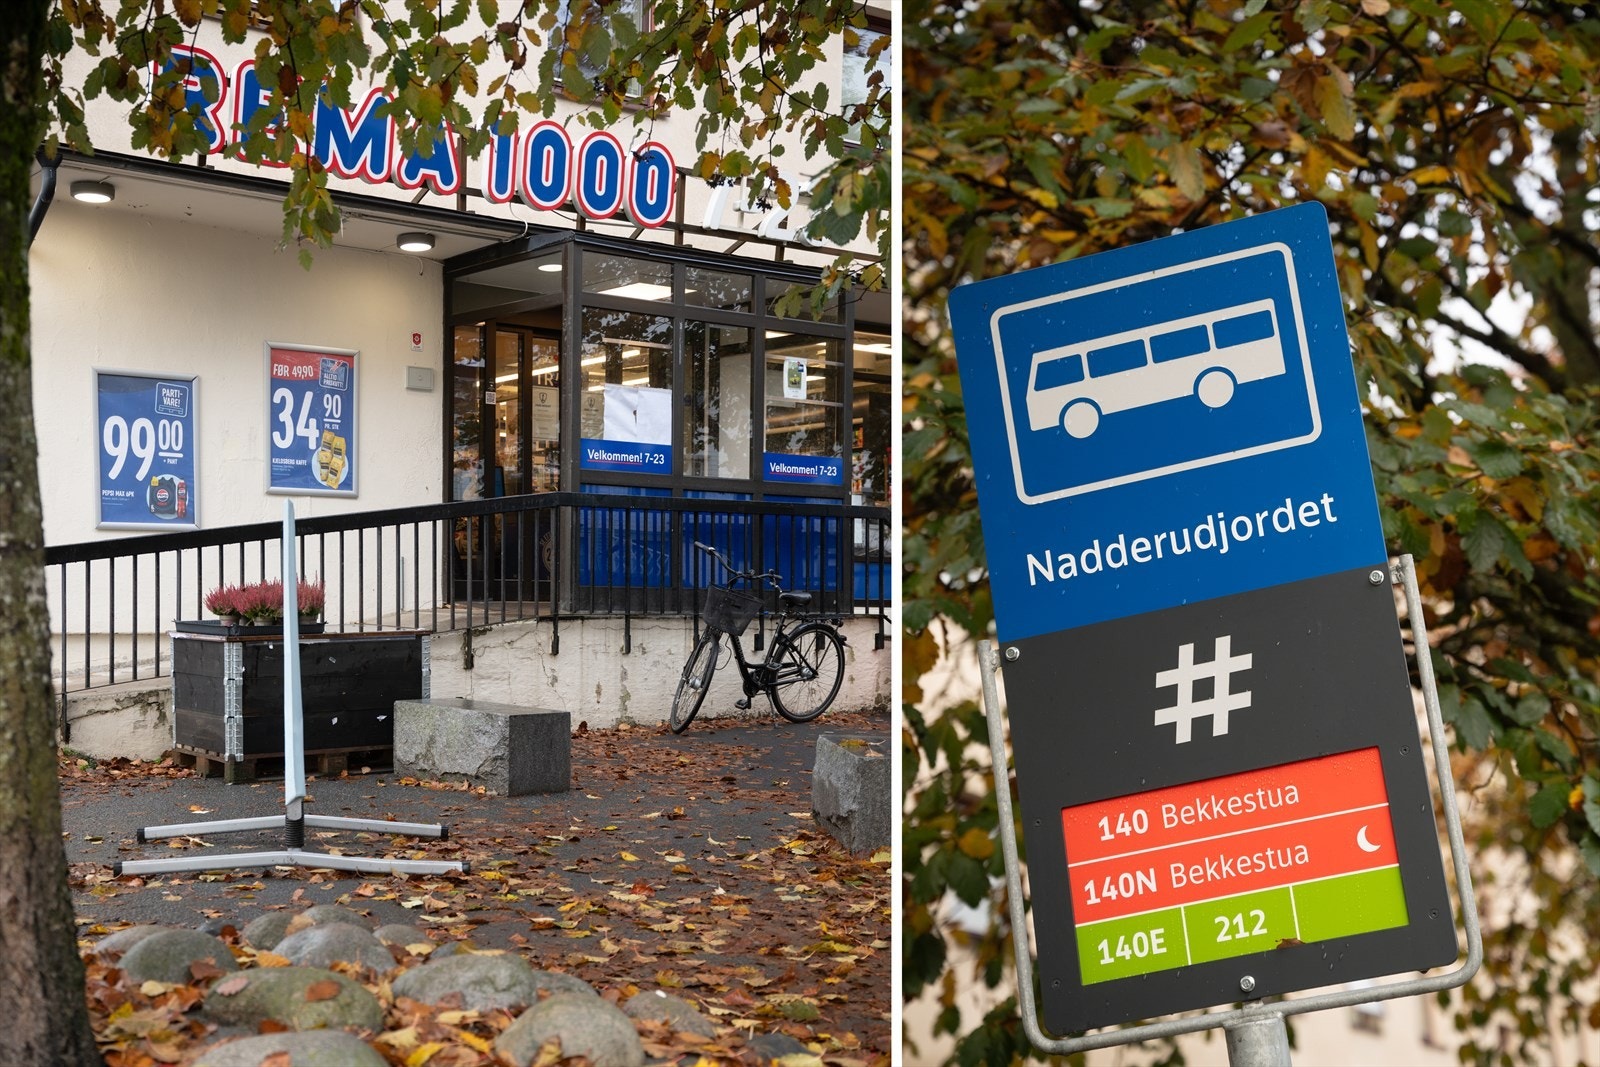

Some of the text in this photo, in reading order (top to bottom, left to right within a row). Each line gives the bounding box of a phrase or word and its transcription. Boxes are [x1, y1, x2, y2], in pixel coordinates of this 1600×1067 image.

[480, 112, 676, 228] 1000
[273, 363, 314, 379] FØR 49,90
[161, 387, 183, 398] PARTI-
[162, 396, 181, 407] VARE!
[272, 387, 342, 450] 34 90
[103, 415, 184, 482] 99 00
[587, 449, 665, 465] Velkommen! 7-23
[769, 462, 838, 477] Velkommen! 7-23
[102, 489, 115, 497] PEPSI
[115, 490, 126, 498] MAX
[1026, 492, 1337, 586] Nadderudjordet
[1098, 784, 1300, 841] 140 Bekkestua
[1084, 844, 1310, 905] 140N Bekkestua
[1214, 910, 1268, 943] 212
[1098, 928, 1167, 965] 140E
